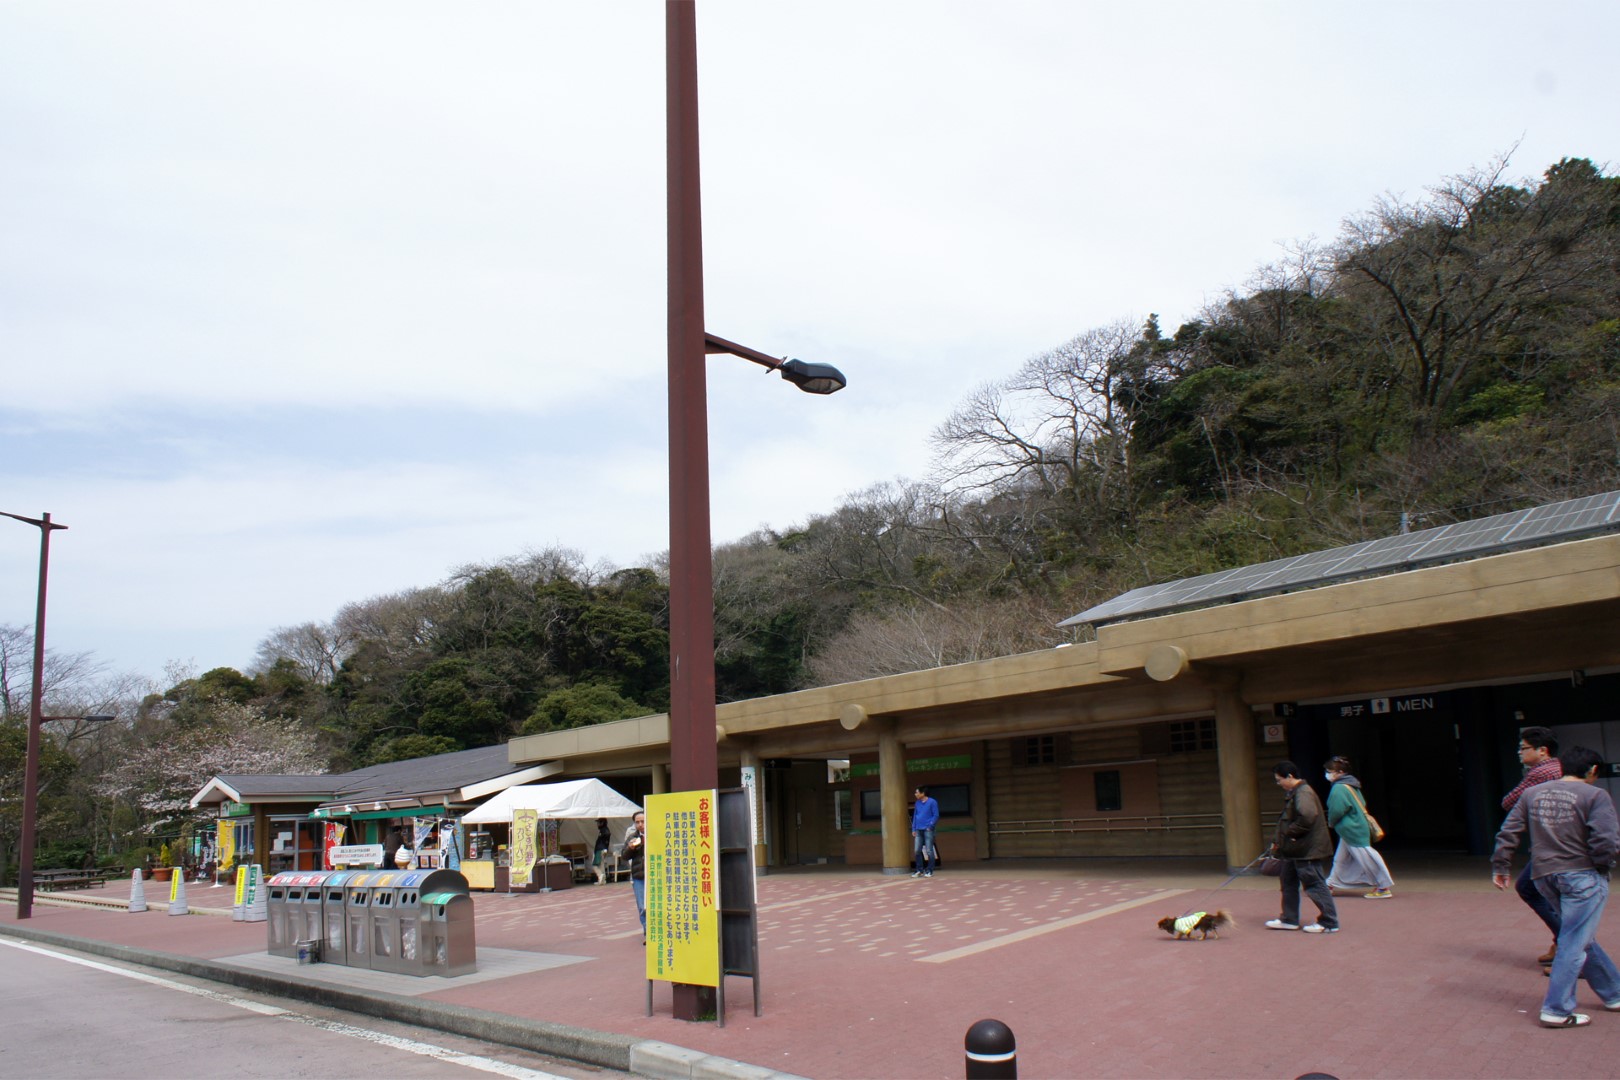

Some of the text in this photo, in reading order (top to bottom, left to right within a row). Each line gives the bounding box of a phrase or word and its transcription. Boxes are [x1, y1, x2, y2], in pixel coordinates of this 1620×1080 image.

[1340, 704, 1365, 717] 男子
[1396, 698, 1434, 712] MEN
[688, 811, 700, 936] 駐車スペース以外での駐車は、
[698, 798, 713, 908] お客様へのお願い
